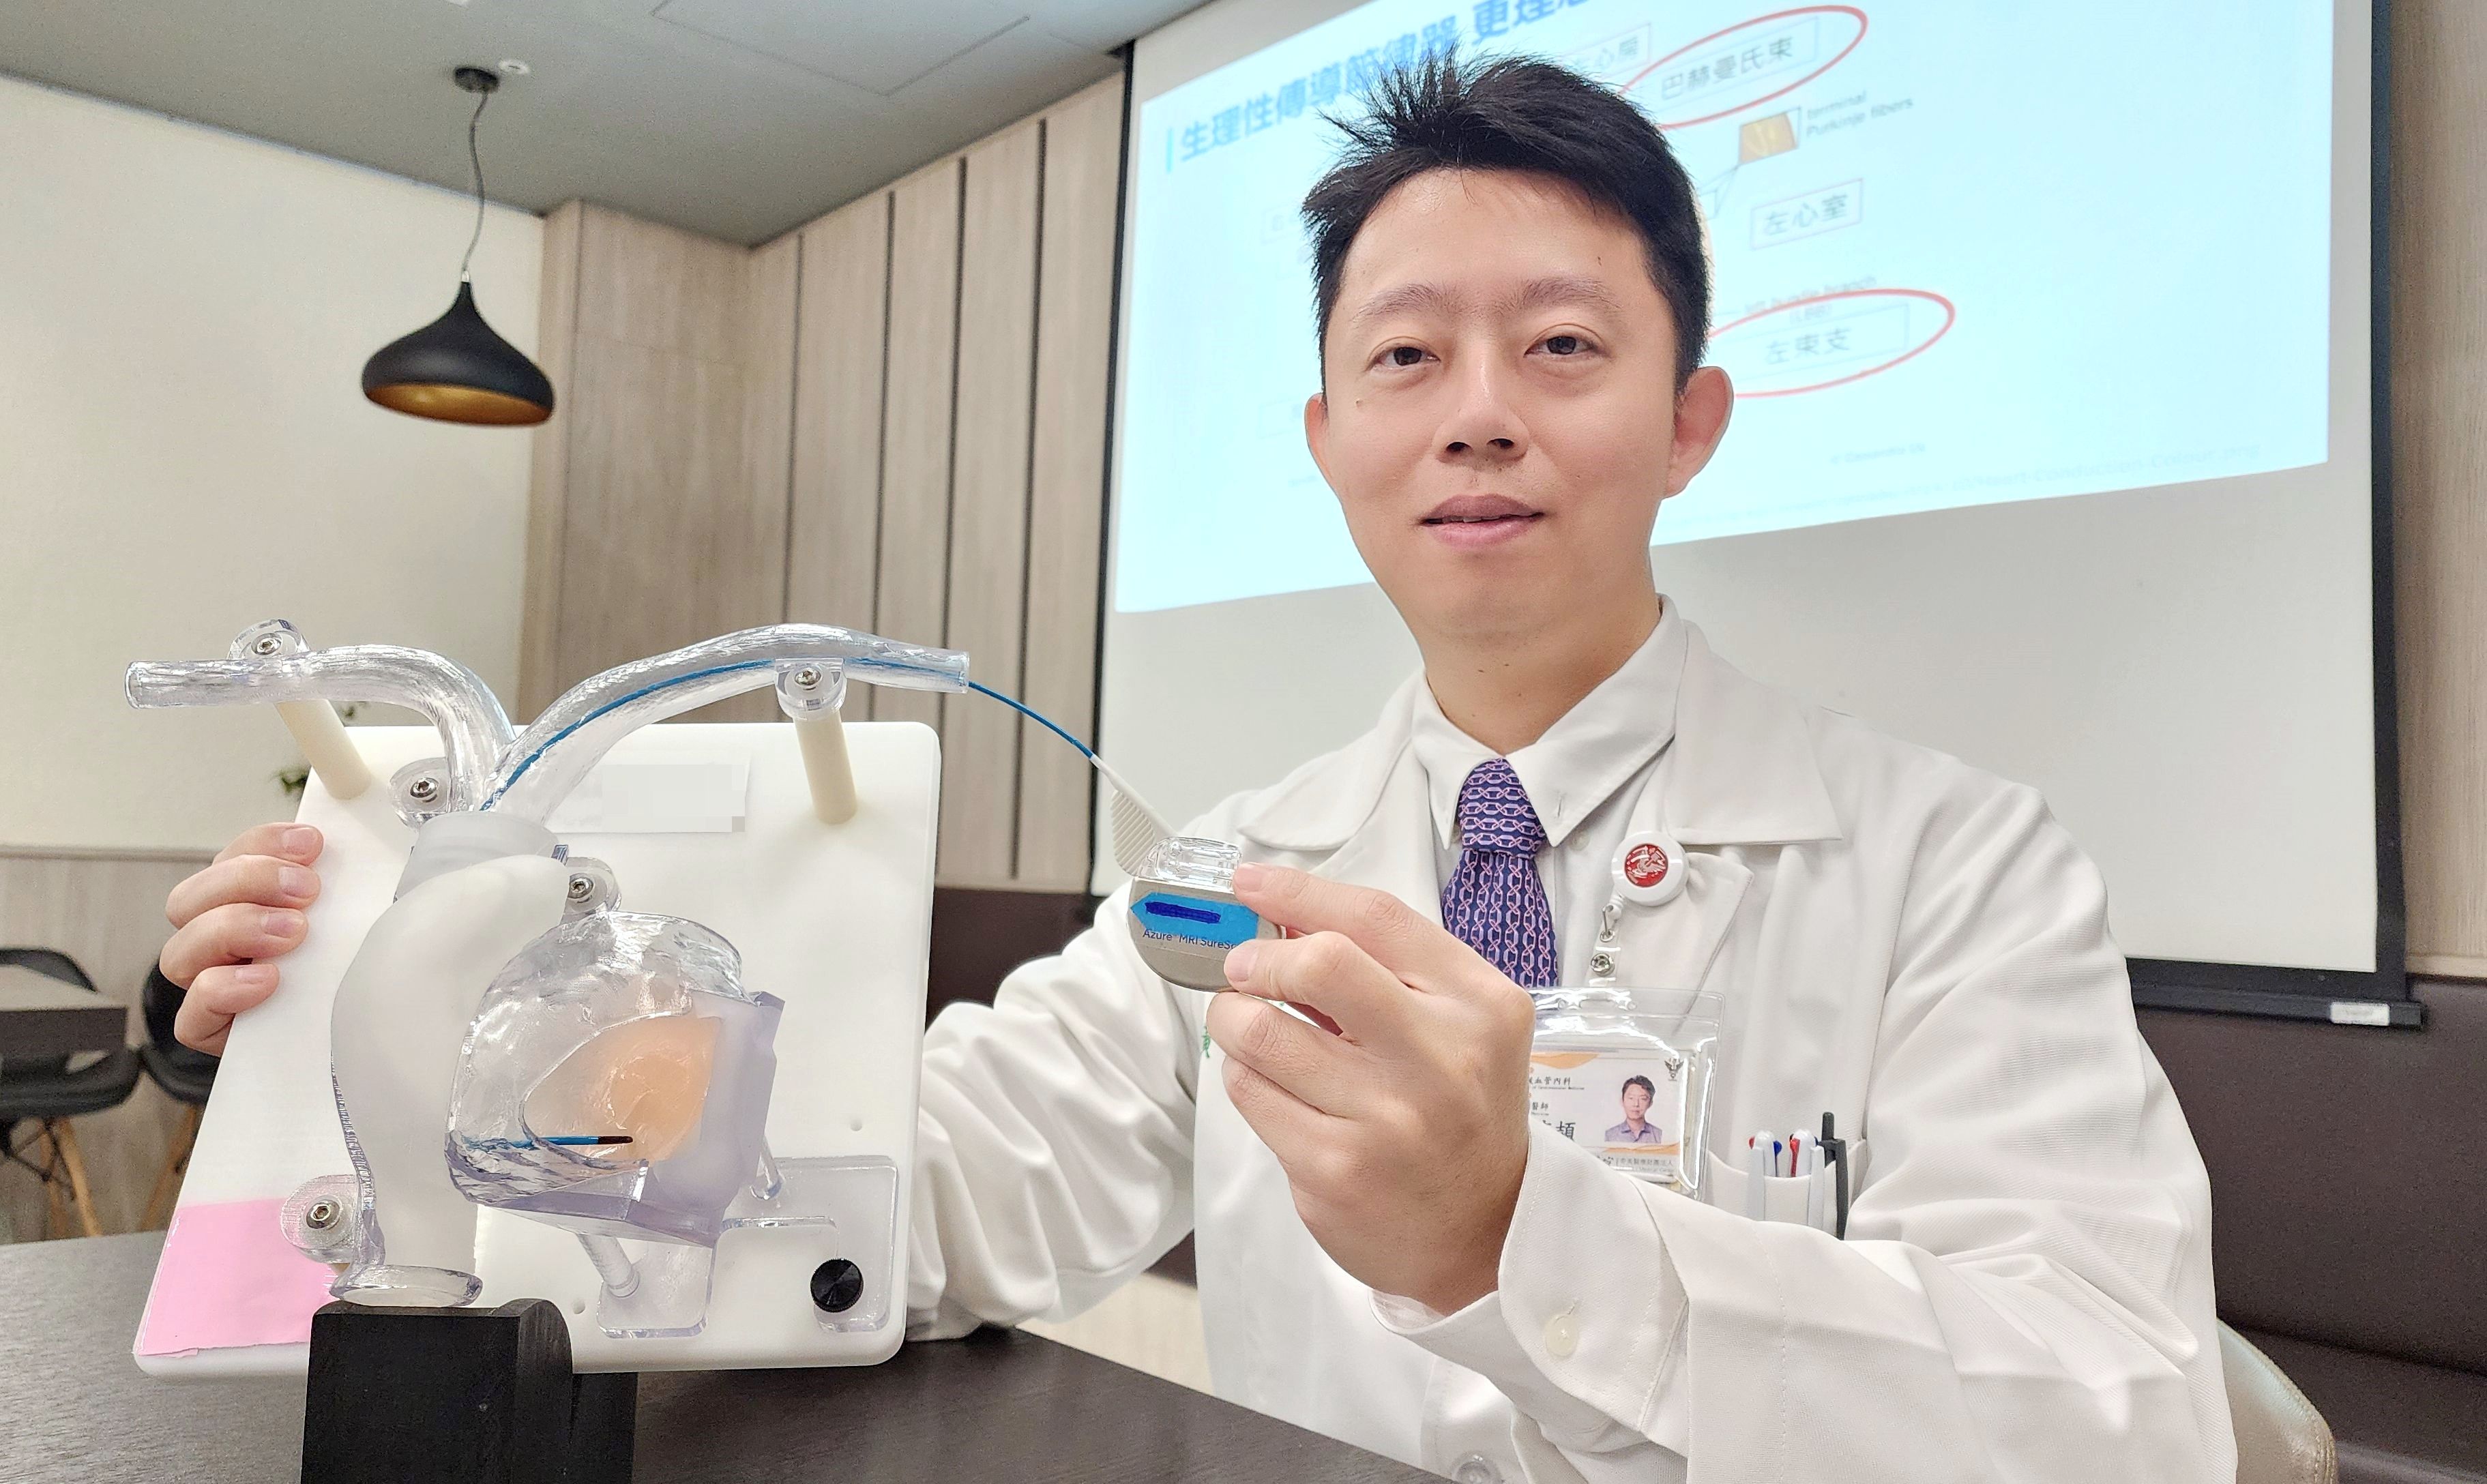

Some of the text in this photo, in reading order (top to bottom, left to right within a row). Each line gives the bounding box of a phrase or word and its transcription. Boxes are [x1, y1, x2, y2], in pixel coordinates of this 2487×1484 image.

[1471, 0, 1591, 46] 更理
[1763, 192, 1848, 236] 左心室
[1179, 933, 1198, 945] MRI
